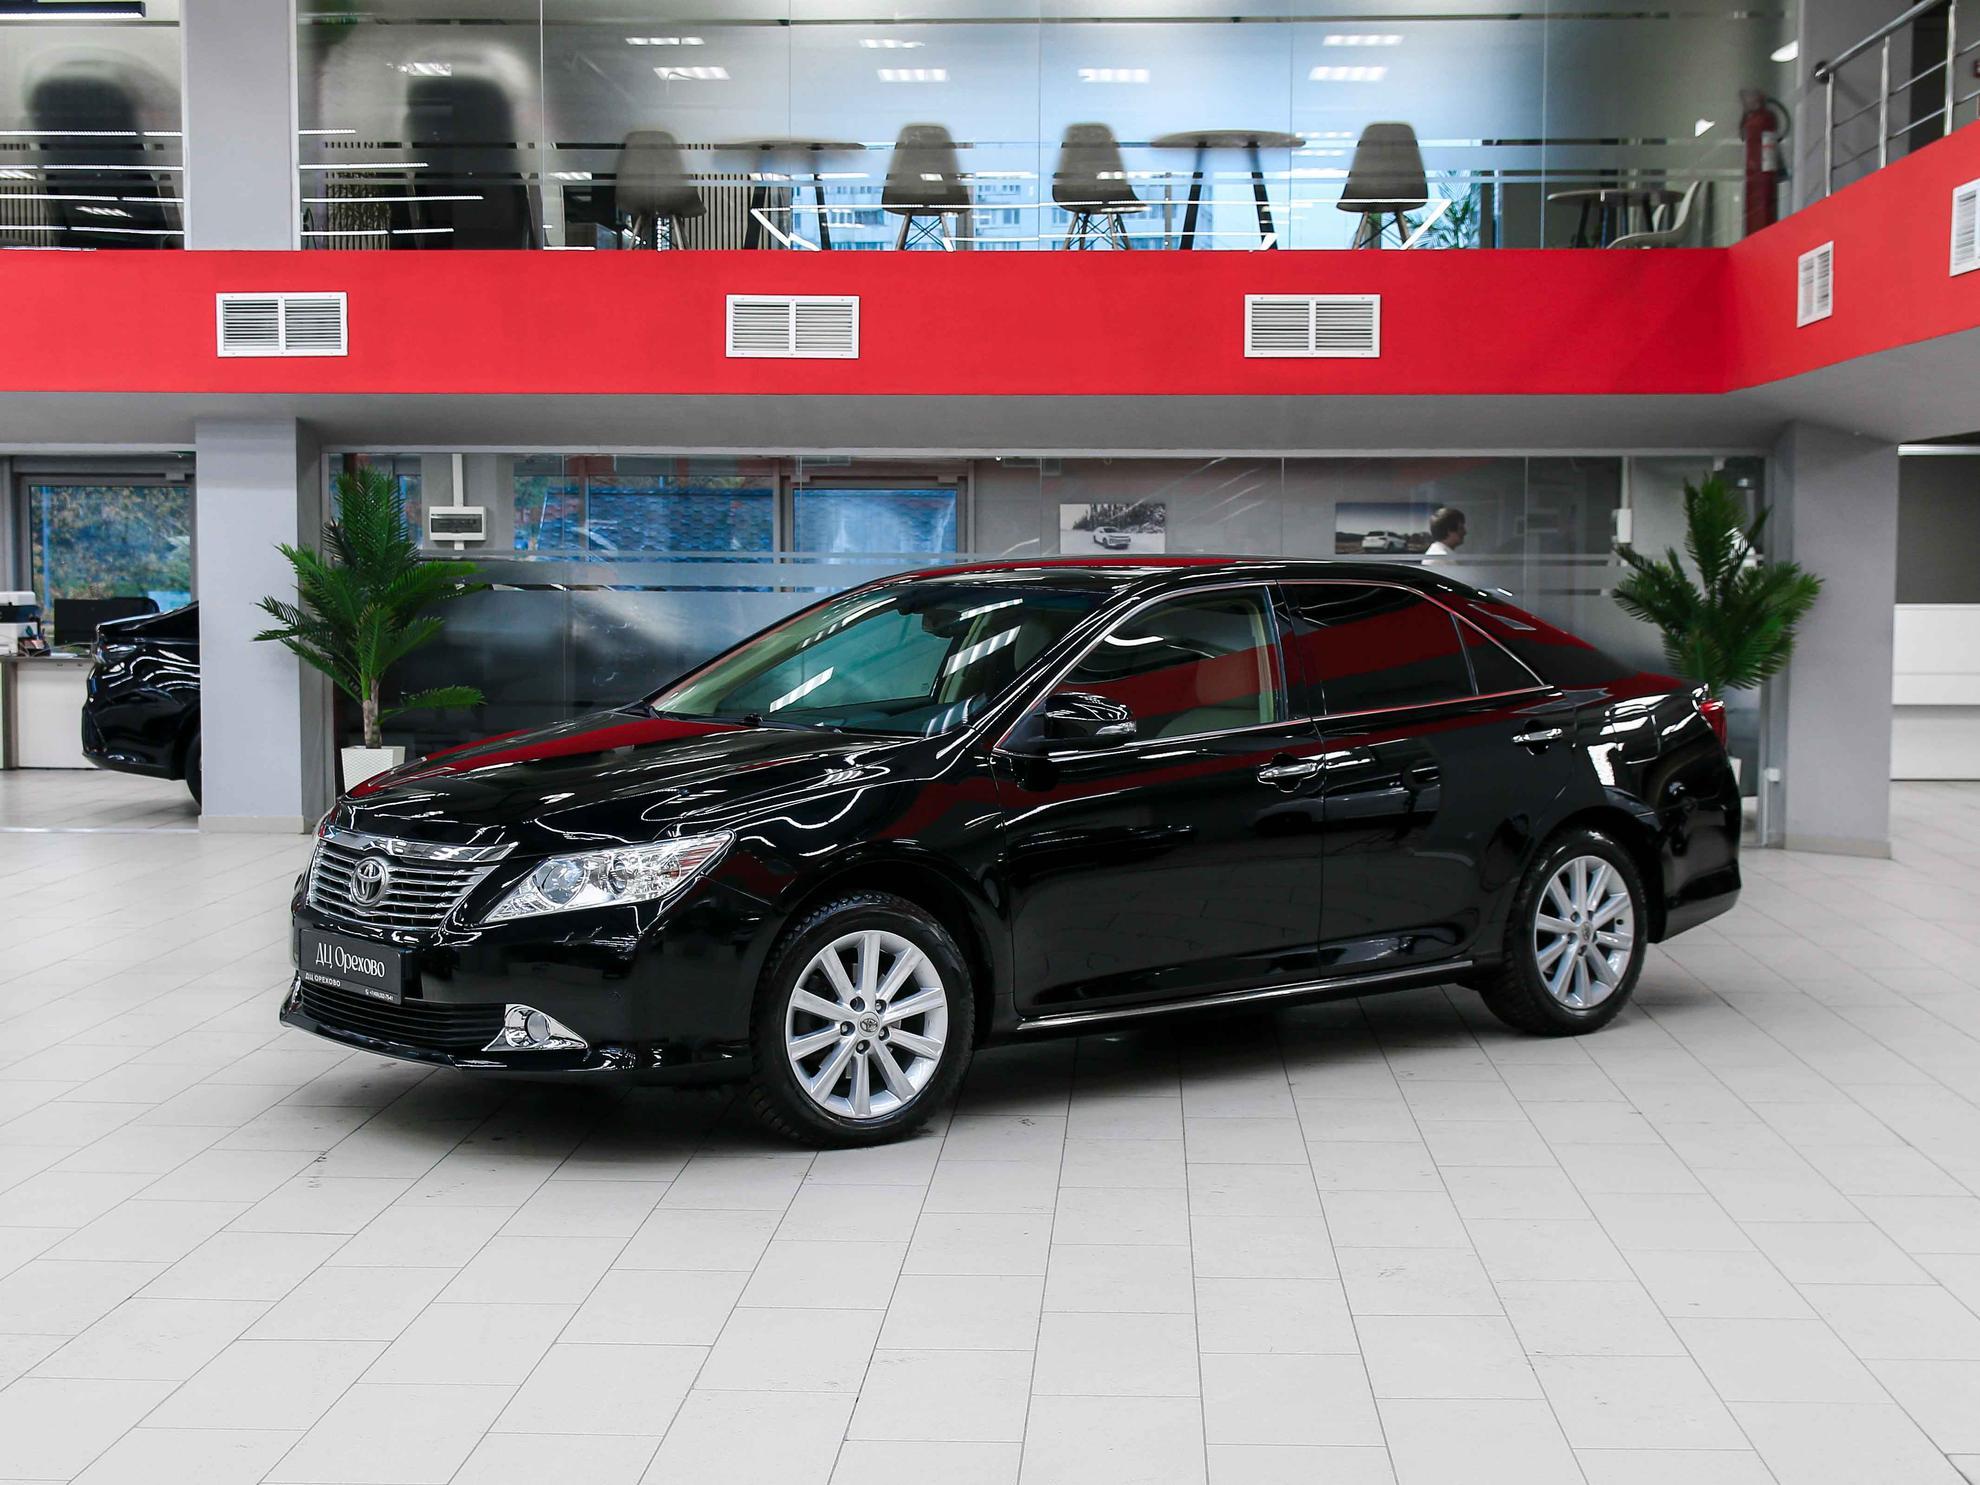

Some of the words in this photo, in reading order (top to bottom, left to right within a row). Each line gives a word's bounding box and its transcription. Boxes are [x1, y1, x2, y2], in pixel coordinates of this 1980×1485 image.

[315, 942, 333, 969] ДЦ
[334, 946, 385, 978] Орехово
[314, 974, 341, 987] ОРЕХОВО
